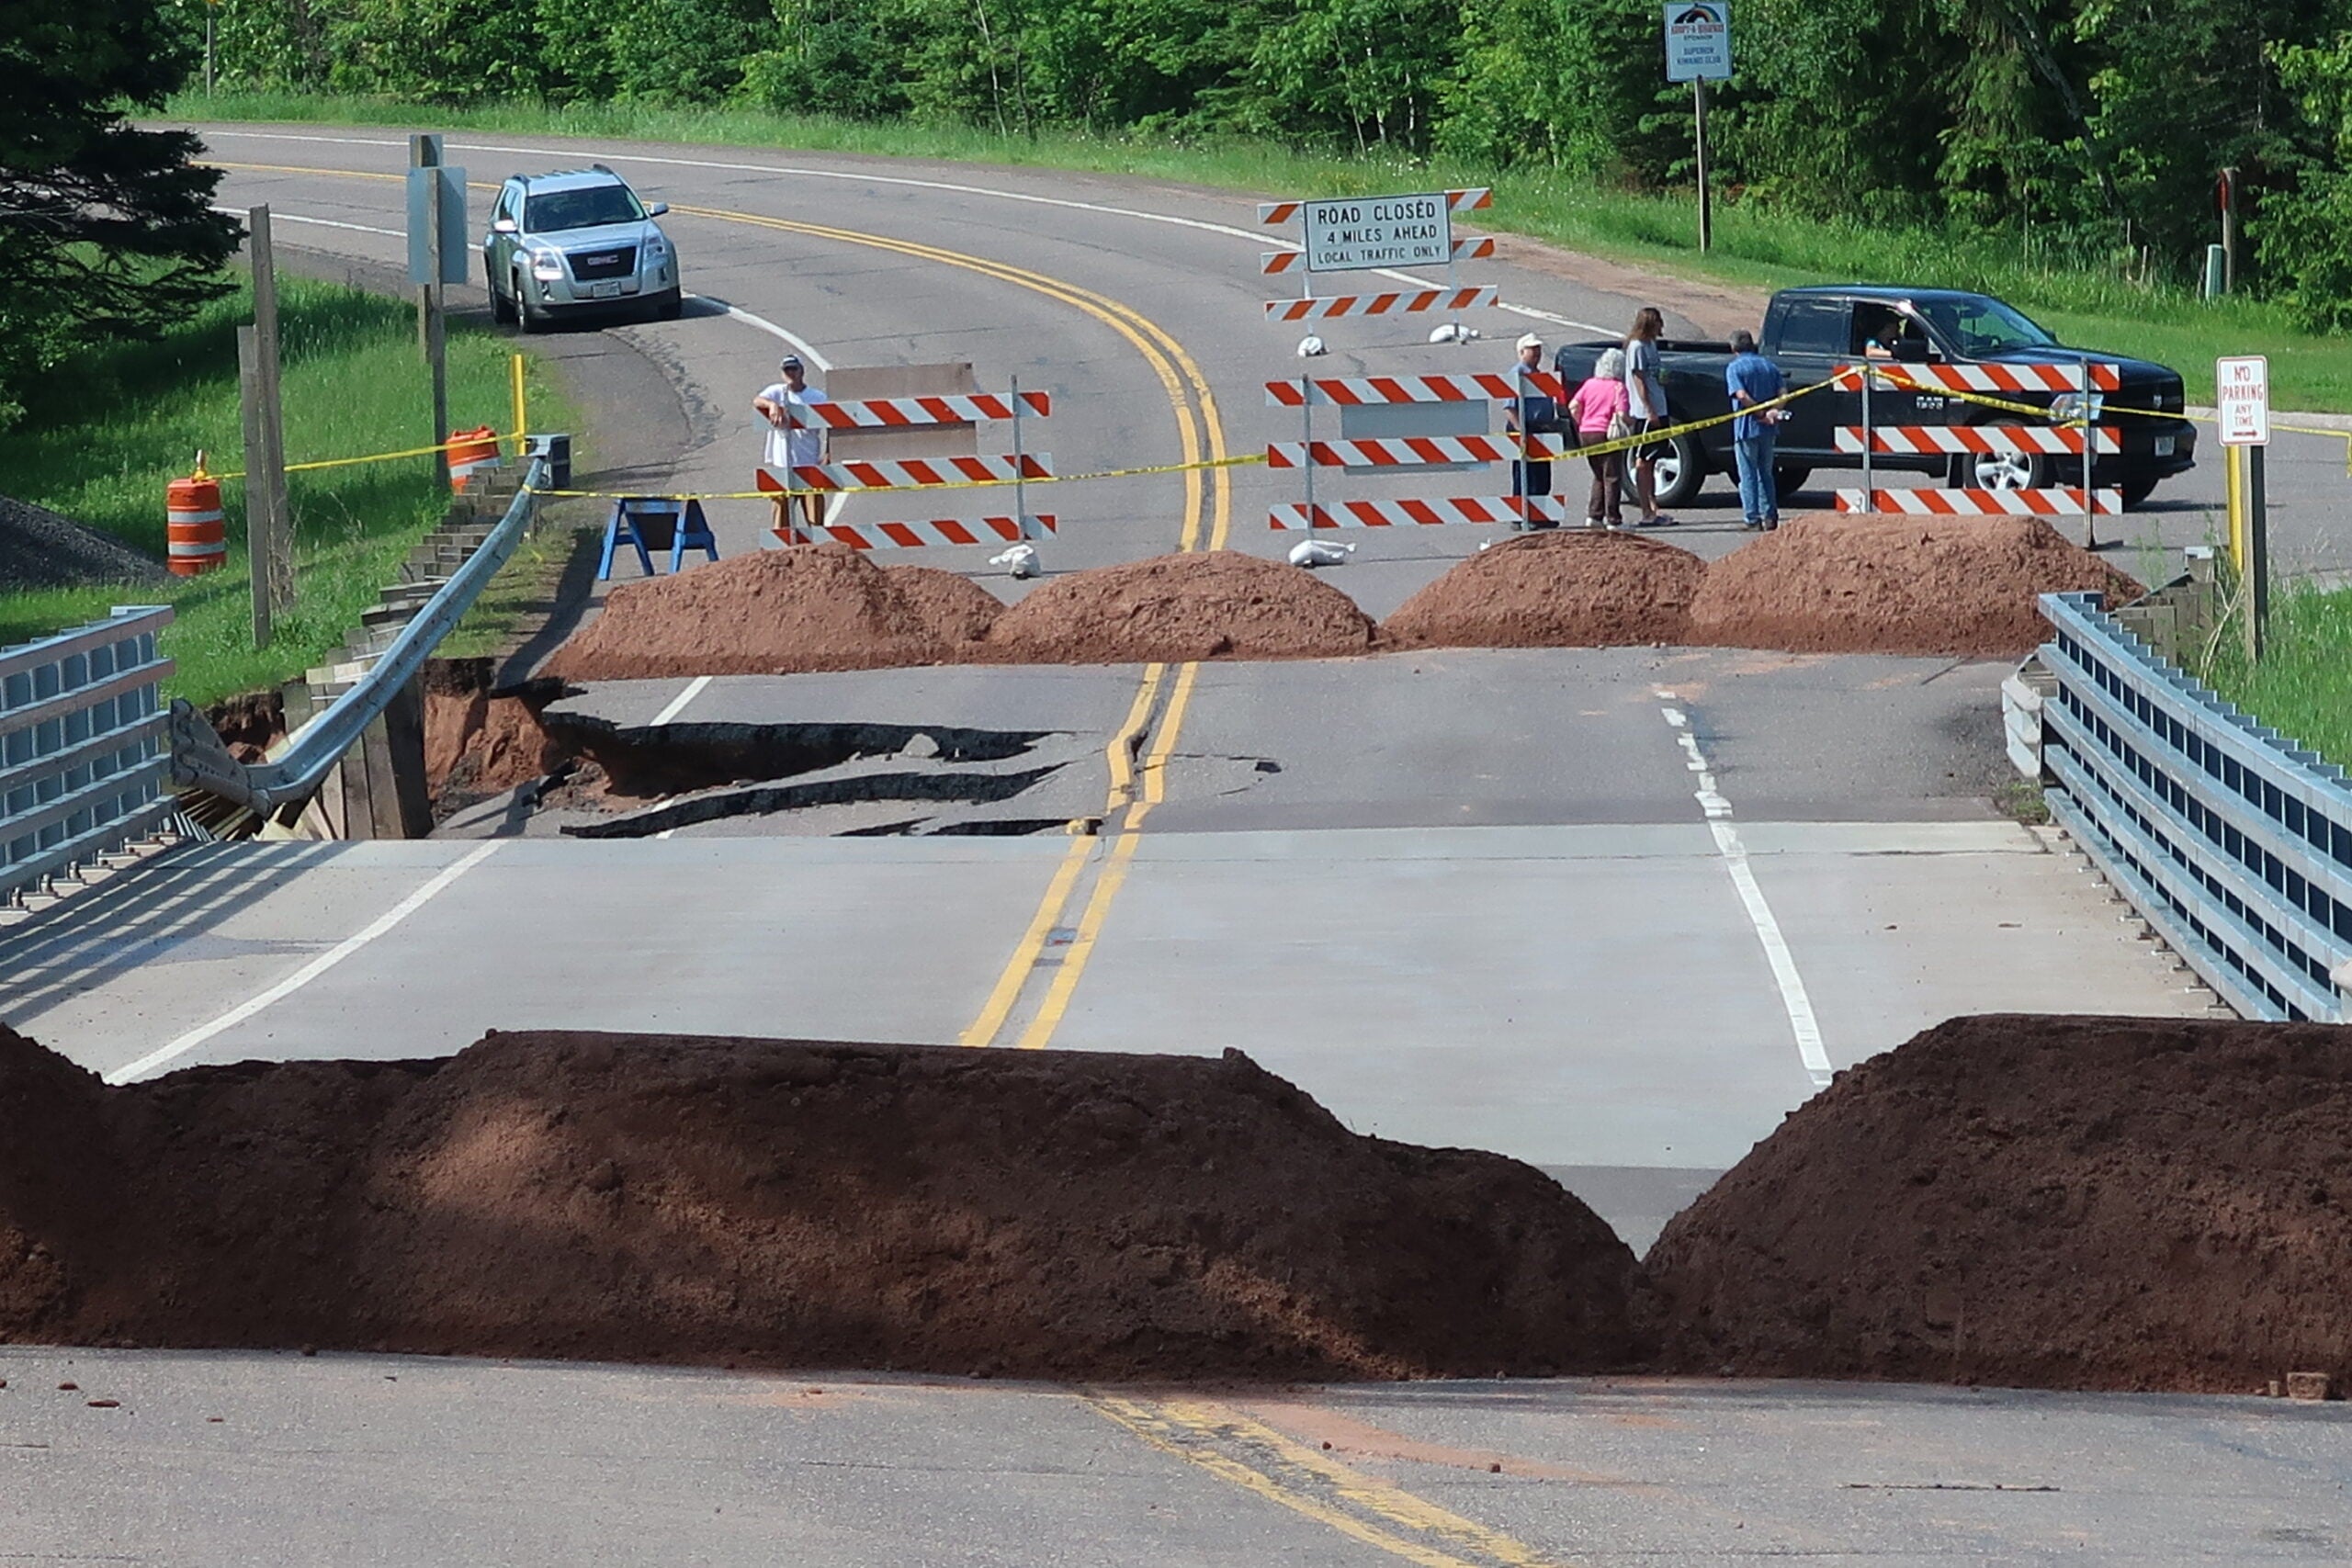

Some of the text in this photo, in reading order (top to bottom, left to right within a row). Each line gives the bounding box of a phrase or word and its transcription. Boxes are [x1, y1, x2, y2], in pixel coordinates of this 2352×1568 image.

[1317, 201, 1435, 225] ROAD CLOSED
[1327, 224, 1437, 244] 4 MILES AHEAD
[1317, 244, 1442, 265] LOCAL TRAFFIC ONLY
[2233, 366, 2251, 382] NO
[2222, 384, 2264, 401] PARKING
[2234, 404, 2253, 415] ANY
[2234, 415, 2254, 426] TIME
